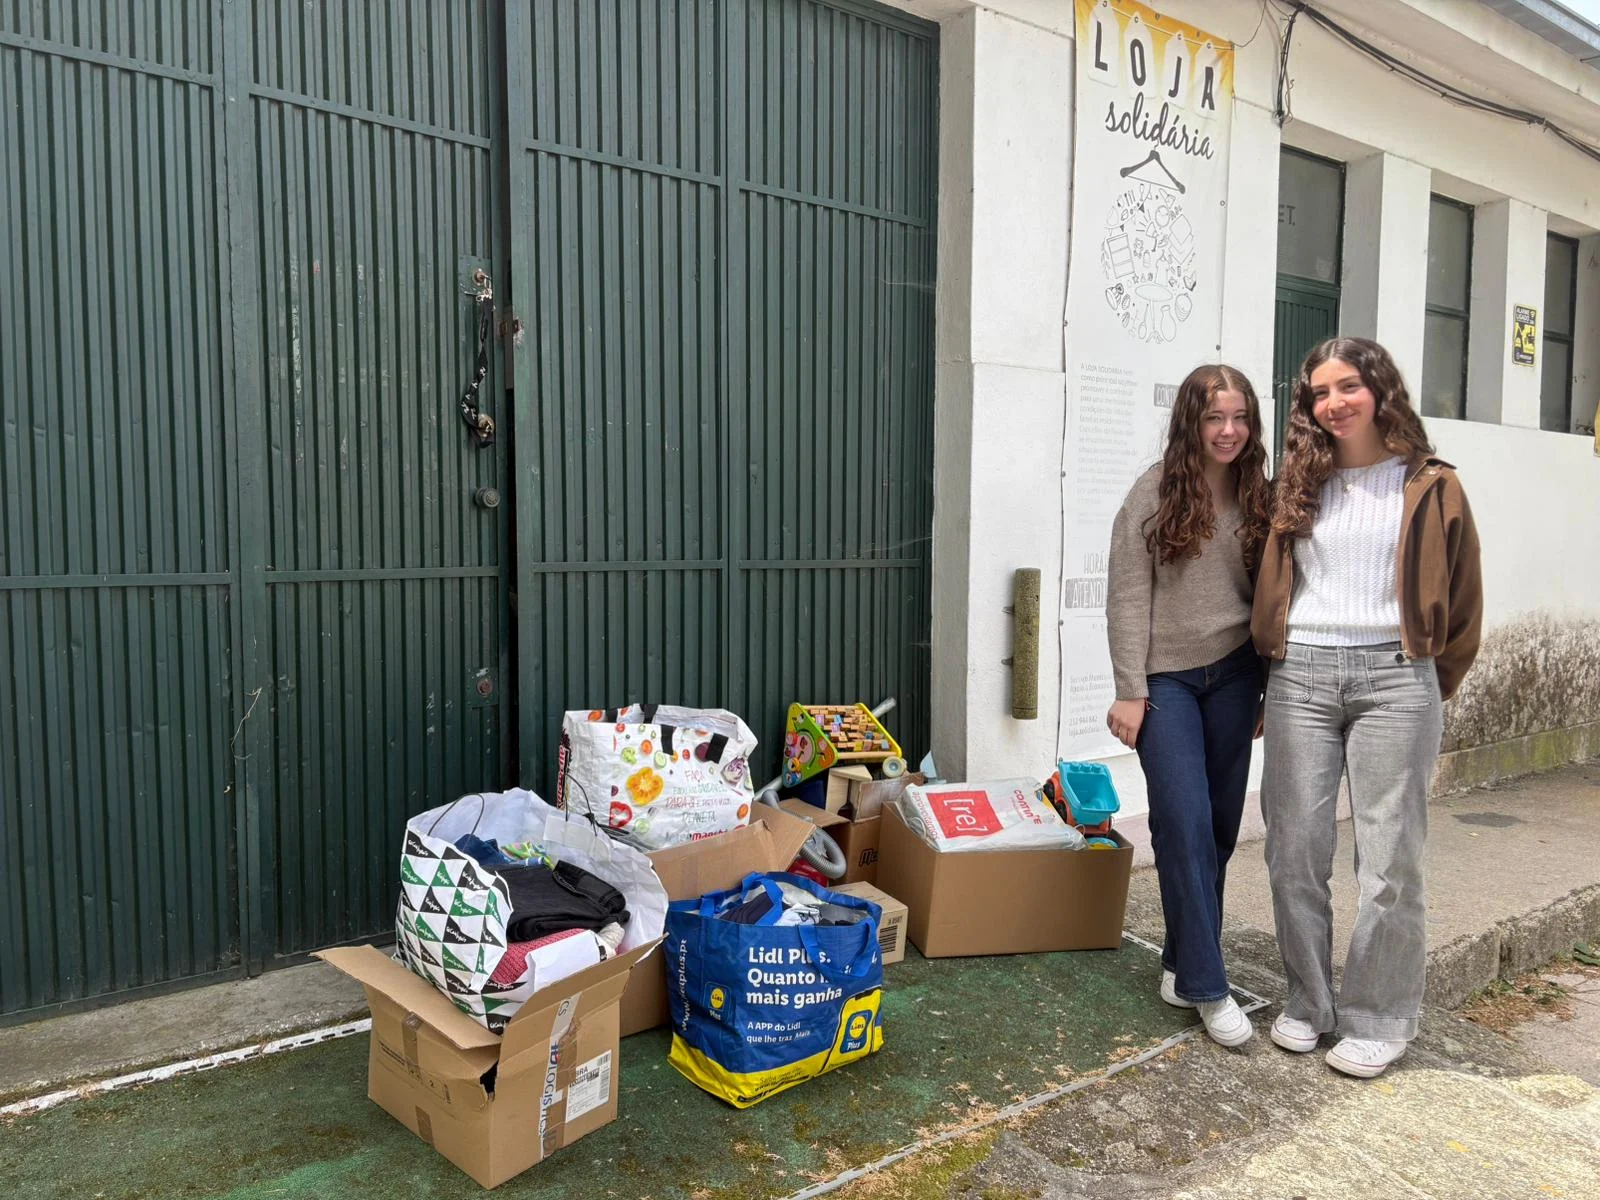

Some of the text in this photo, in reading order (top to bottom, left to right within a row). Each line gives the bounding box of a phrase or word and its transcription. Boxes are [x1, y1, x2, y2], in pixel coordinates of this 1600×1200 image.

[1094, 20, 1215, 111] LOJA
[1105, 91, 1215, 160] solidária
[748, 946, 784, 964] Lidl
[747, 968, 816, 988] Quanto
[746, 987, 843, 1009] mais ganha
[747, 1021, 801, 1032] A APP do Lidl
[746, 1035, 763, 1044] que
[764, 1034, 777, 1043] lhe
